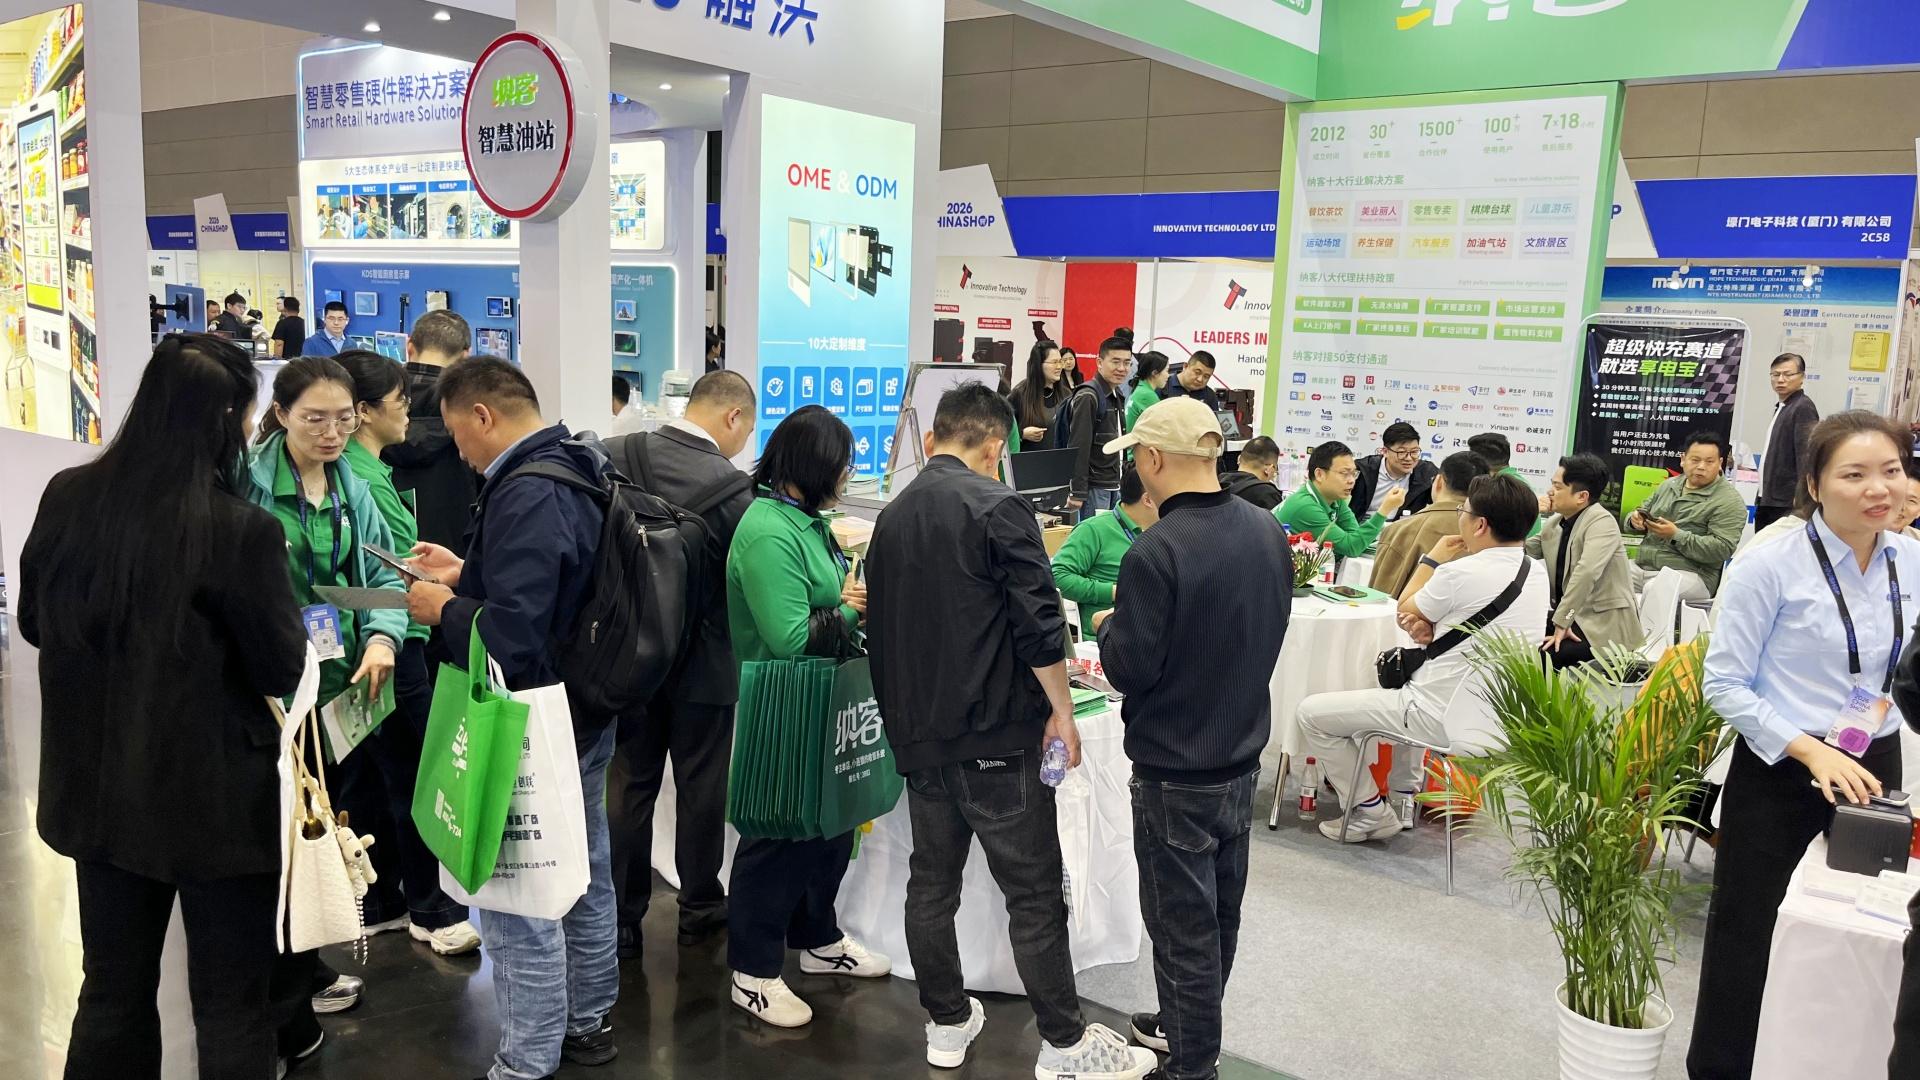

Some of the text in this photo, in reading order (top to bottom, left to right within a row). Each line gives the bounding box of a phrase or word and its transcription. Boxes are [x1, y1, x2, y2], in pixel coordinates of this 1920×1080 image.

[305, 67, 472, 111] 智慧零售硬件解决方案
[493, 71, 539, 108] 纳客
[306, 114, 333, 129] Smart
[336, 111, 363, 128] Retail
[366, 107, 415, 126] Hardware
[478, 119, 556, 155] 智慧油站
[1310, 126, 1346, 142] 2012
[787, 163, 897, 200] OME & ODM
[1306, 174, 1405, 188] 纳客十大行业解决方案
[946, 202, 973, 214] 2026
[1360, 205, 1398, 217] 美业丽人
[937, 215, 996, 228] HINASHOP
[1153, 223, 1276, 233] INNOVATIVE TECHNOLOGY LTD
[201, 224, 229, 233] CHINASHOP
[1357, 237, 1394, 249] 养生保健
[1466, 237, 1507, 249] 加油气站
[1524, 236, 1568, 249] 文旅景区
[1860, 232, 1891, 243] 2C58
[970, 282, 1028, 295] Innovative Technology
[1662, 307, 1693, 316] Company
[1194, 330, 1250, 345] LEADERS
[807, 337, 867, 352] 10大定制维度
[1603, 338, 1726, 360] 超级快充赛道
[1612, 430, 1670, 440] 当用户还在为充电
[1610, 447, 1685, 458] 我们已用核心技术抢占
